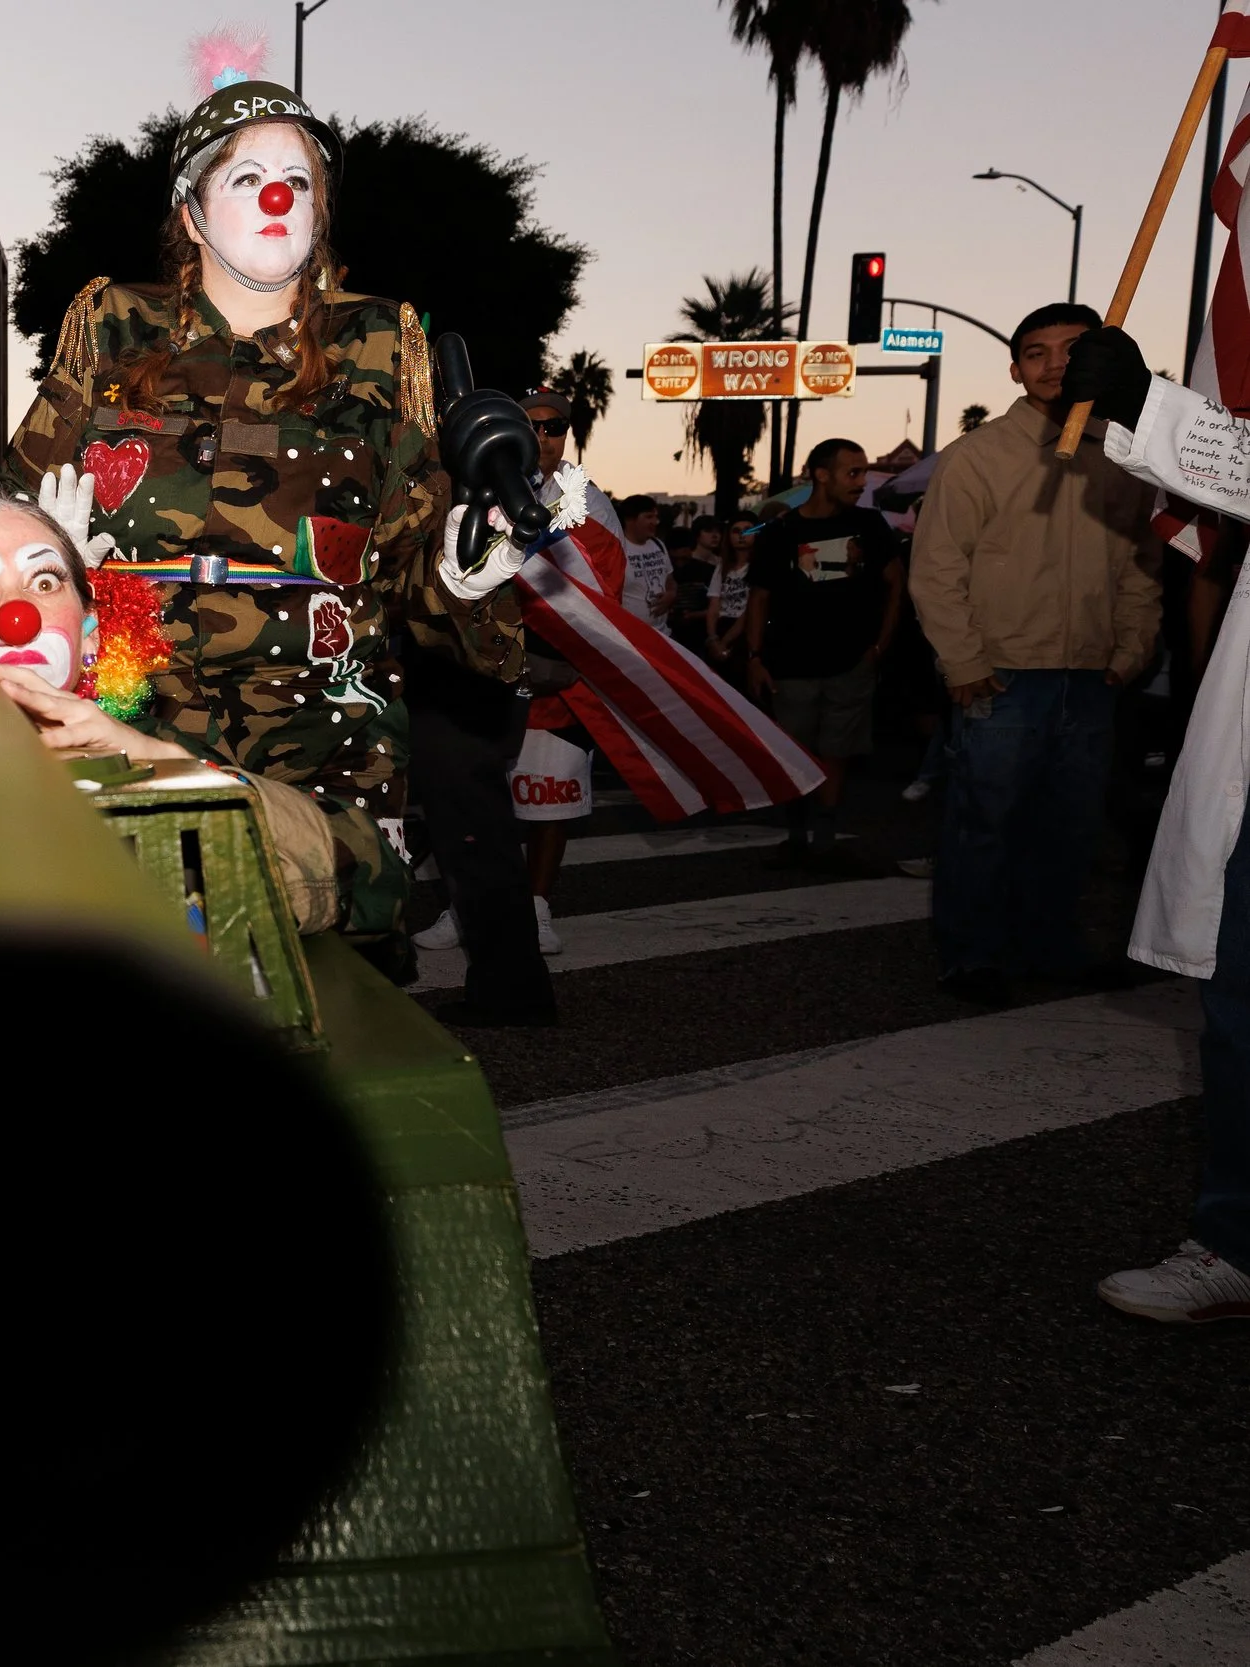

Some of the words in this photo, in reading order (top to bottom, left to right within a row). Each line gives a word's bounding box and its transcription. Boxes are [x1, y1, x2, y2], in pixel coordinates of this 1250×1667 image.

[886, 332, 939, 348] Alameda
[653, 354, 670, 365] DO
[673, 353, 692, 365] NOT
[712, 350, 789, 368] WRONG
[808, 352, 823, 363] DO
[825, 351, 848, 363] NOT
[654, 377, 689, 389] ENTER
[723, 373, 772, 391] WAY
[808, 375, 844, 388] ENTER
[1194, 416, 1206, 427] in
[1209, 422, 1234, 434] orde
[1185, 431, 1225, 447] insure
[1180, 446, 1222, 461] promote
[1227, 454, 1245, 466] the
[1178, 458, 1221, 477] Liberty
[1227, 470, 1242, 482] to
[1184, 474, 1206, 489] this
[1209, 482, 1250, 499] Constit
[512, 774, 582, 806] Coke
